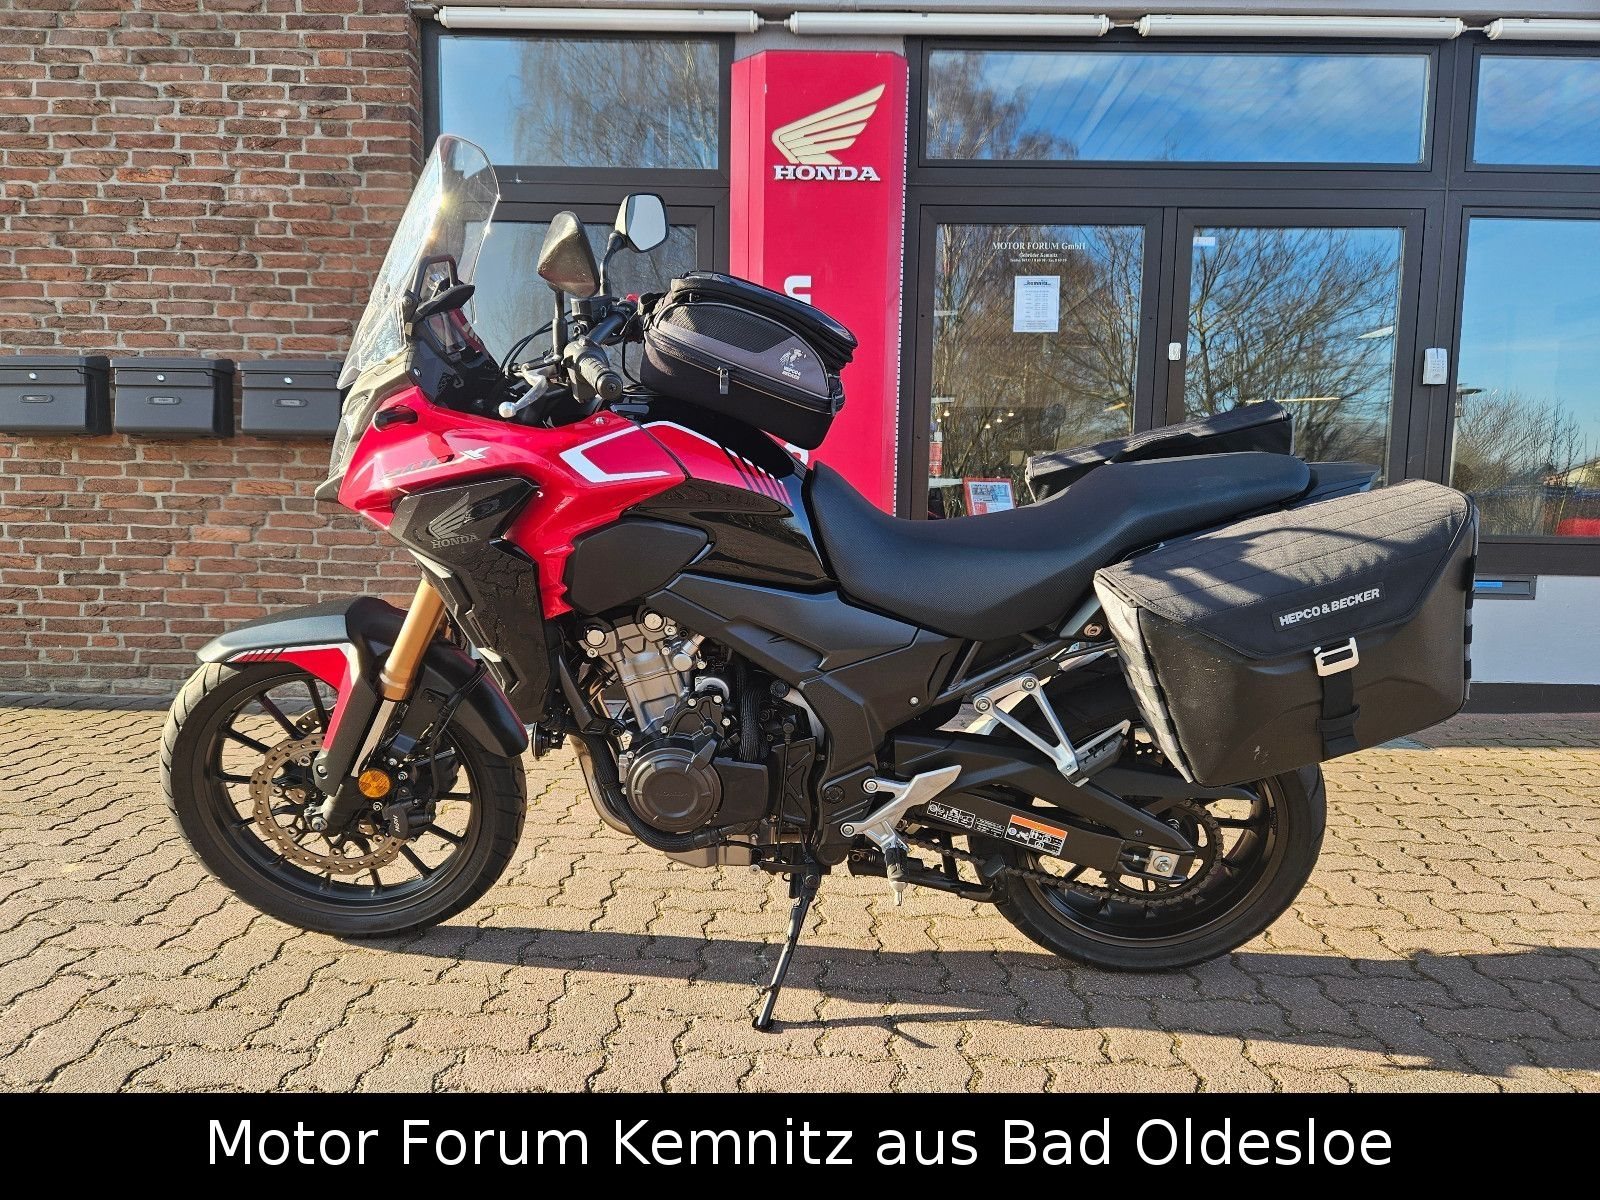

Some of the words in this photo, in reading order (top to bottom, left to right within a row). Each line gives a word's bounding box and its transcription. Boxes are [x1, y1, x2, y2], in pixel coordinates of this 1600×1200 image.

[773, 165, 881, 182] HONDA
[991, 241, 1026, 250] MOTOR
[1027, 241, 1059, 250] FORUM
[1061, 241, 1086, 250] GmbH
[430, 534, 481, 549] HONDA
[1279, 606, 1321, 626] HEPCO
[1321, 603, 1331, 614] &
[1331, 588, 1380, 612] BECKER
